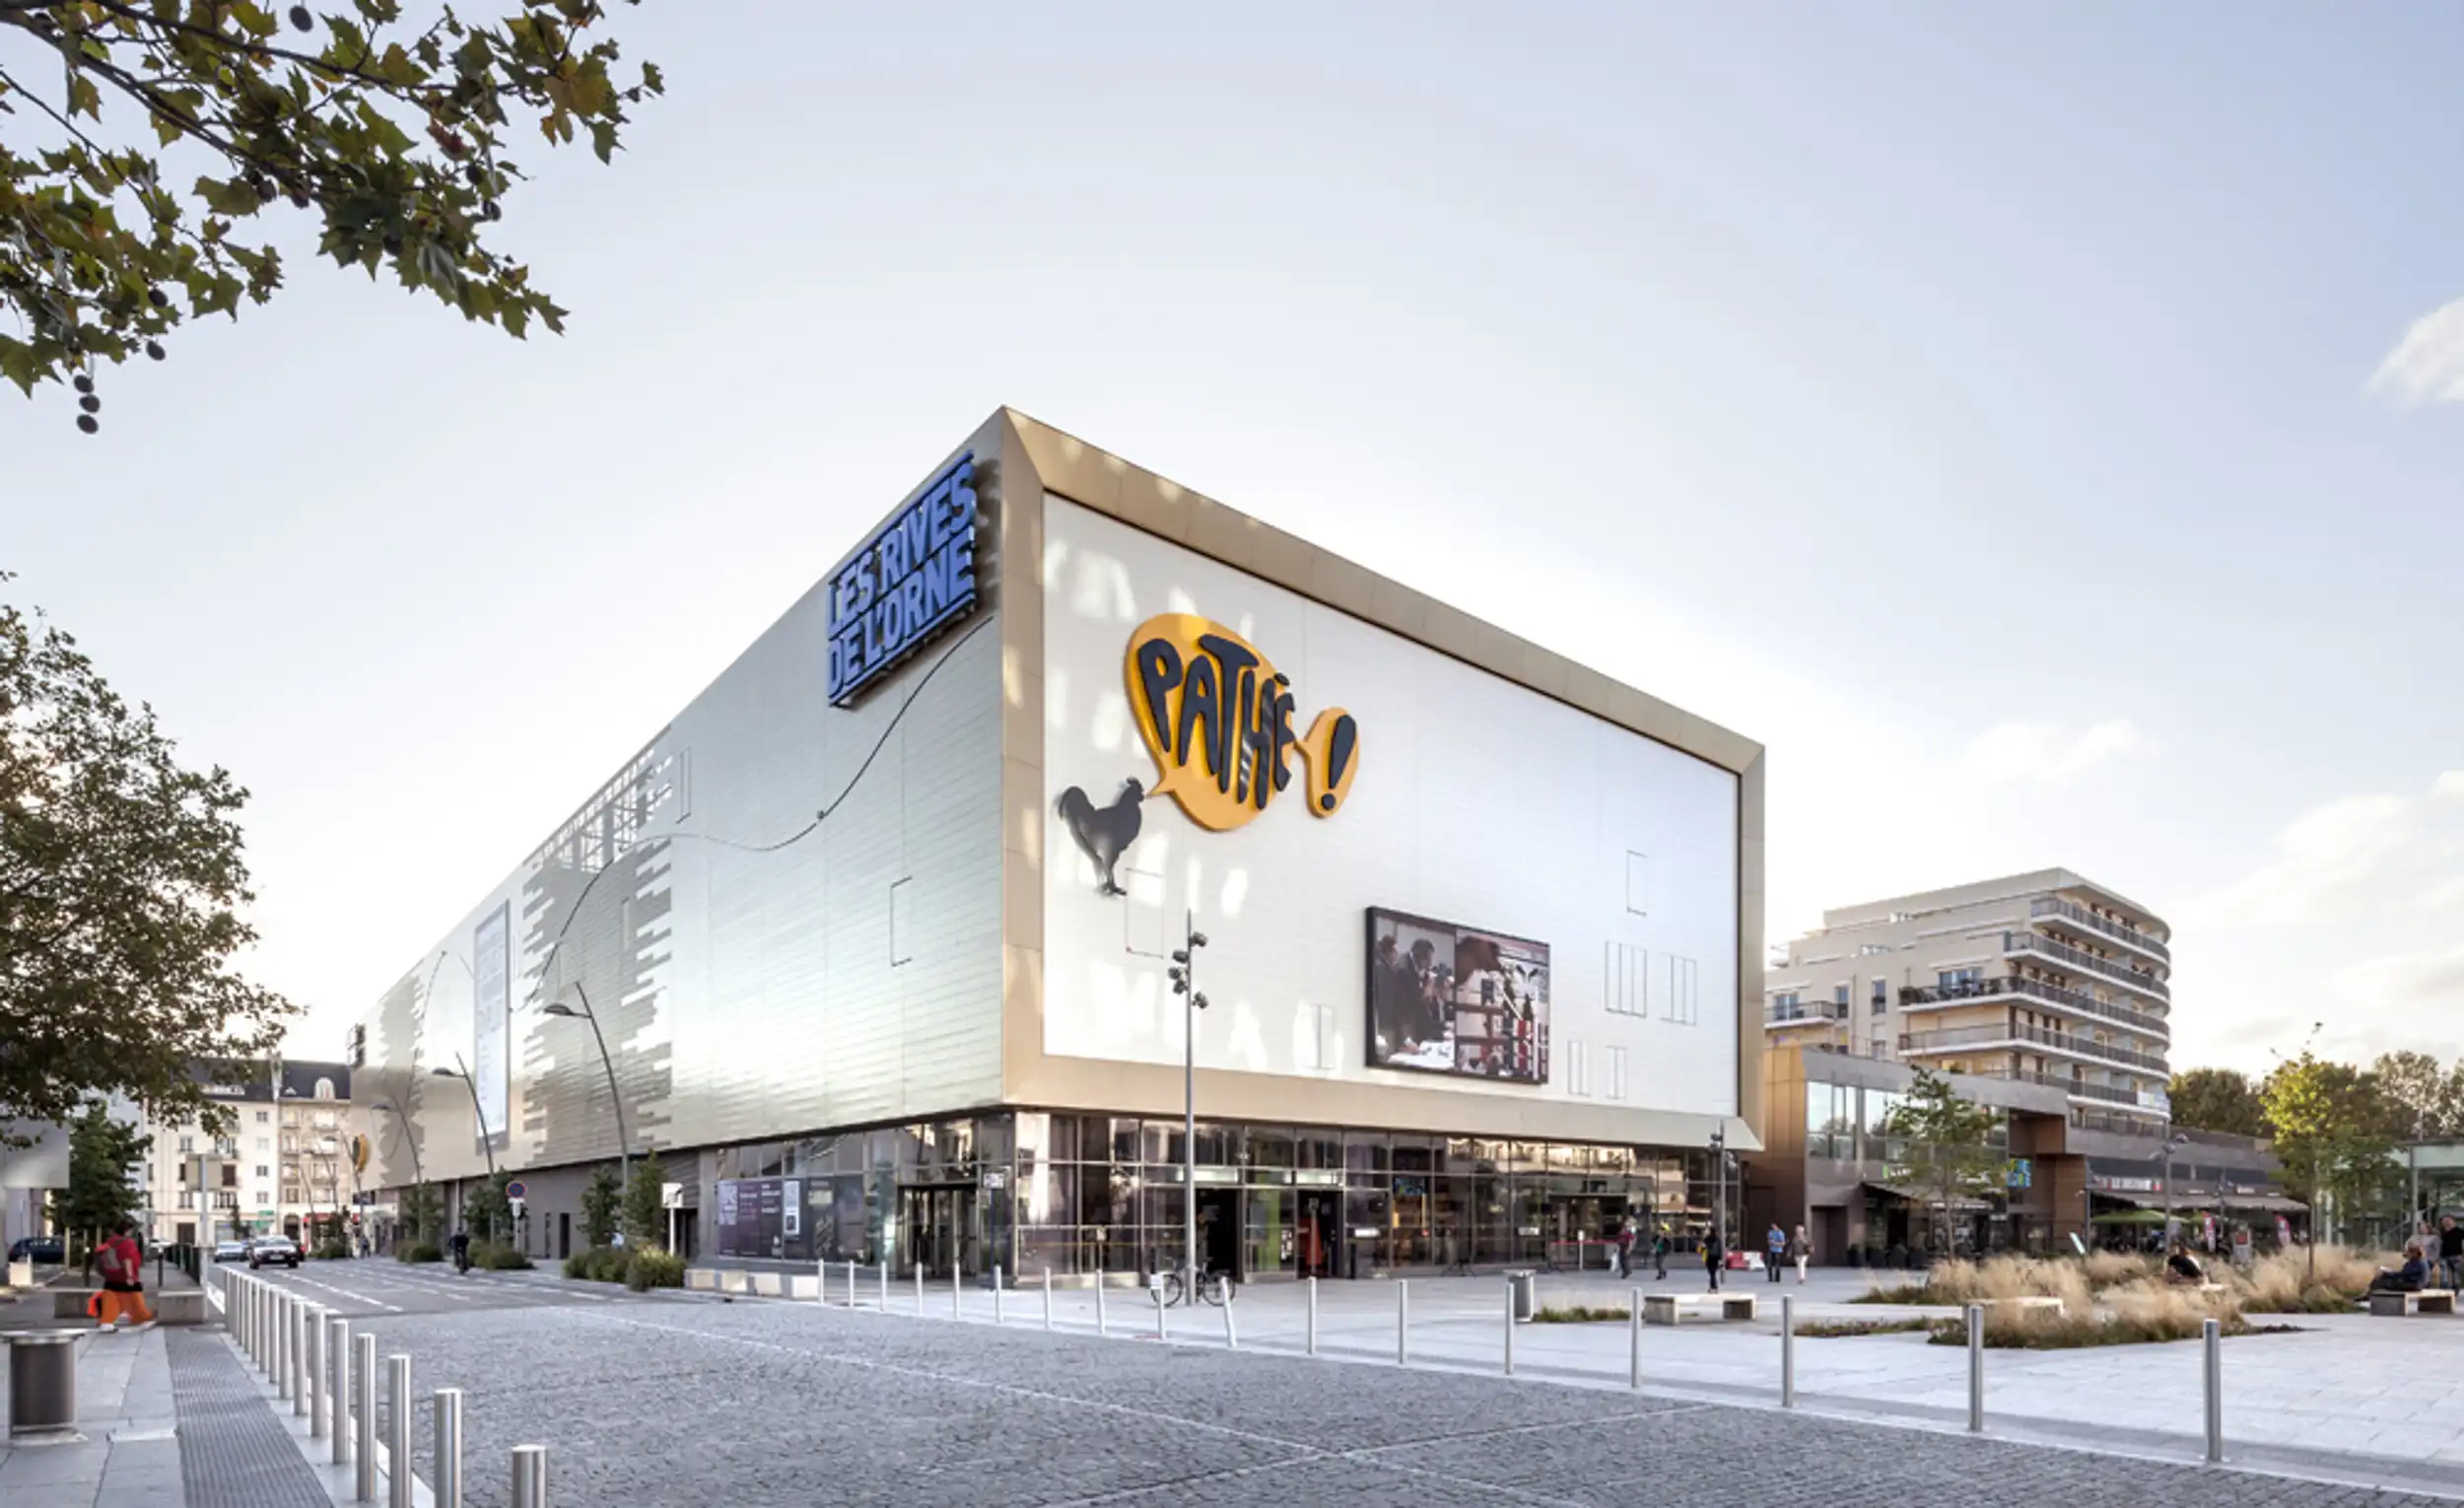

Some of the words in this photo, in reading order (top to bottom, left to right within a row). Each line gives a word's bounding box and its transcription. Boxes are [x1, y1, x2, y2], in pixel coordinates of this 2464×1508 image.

[828, 550, 875, 636] LES
[880, 462, 976, 592] RIVES
[828, 621, 862, 698] DE
[862, 526, 976, 665] L'ORNE
